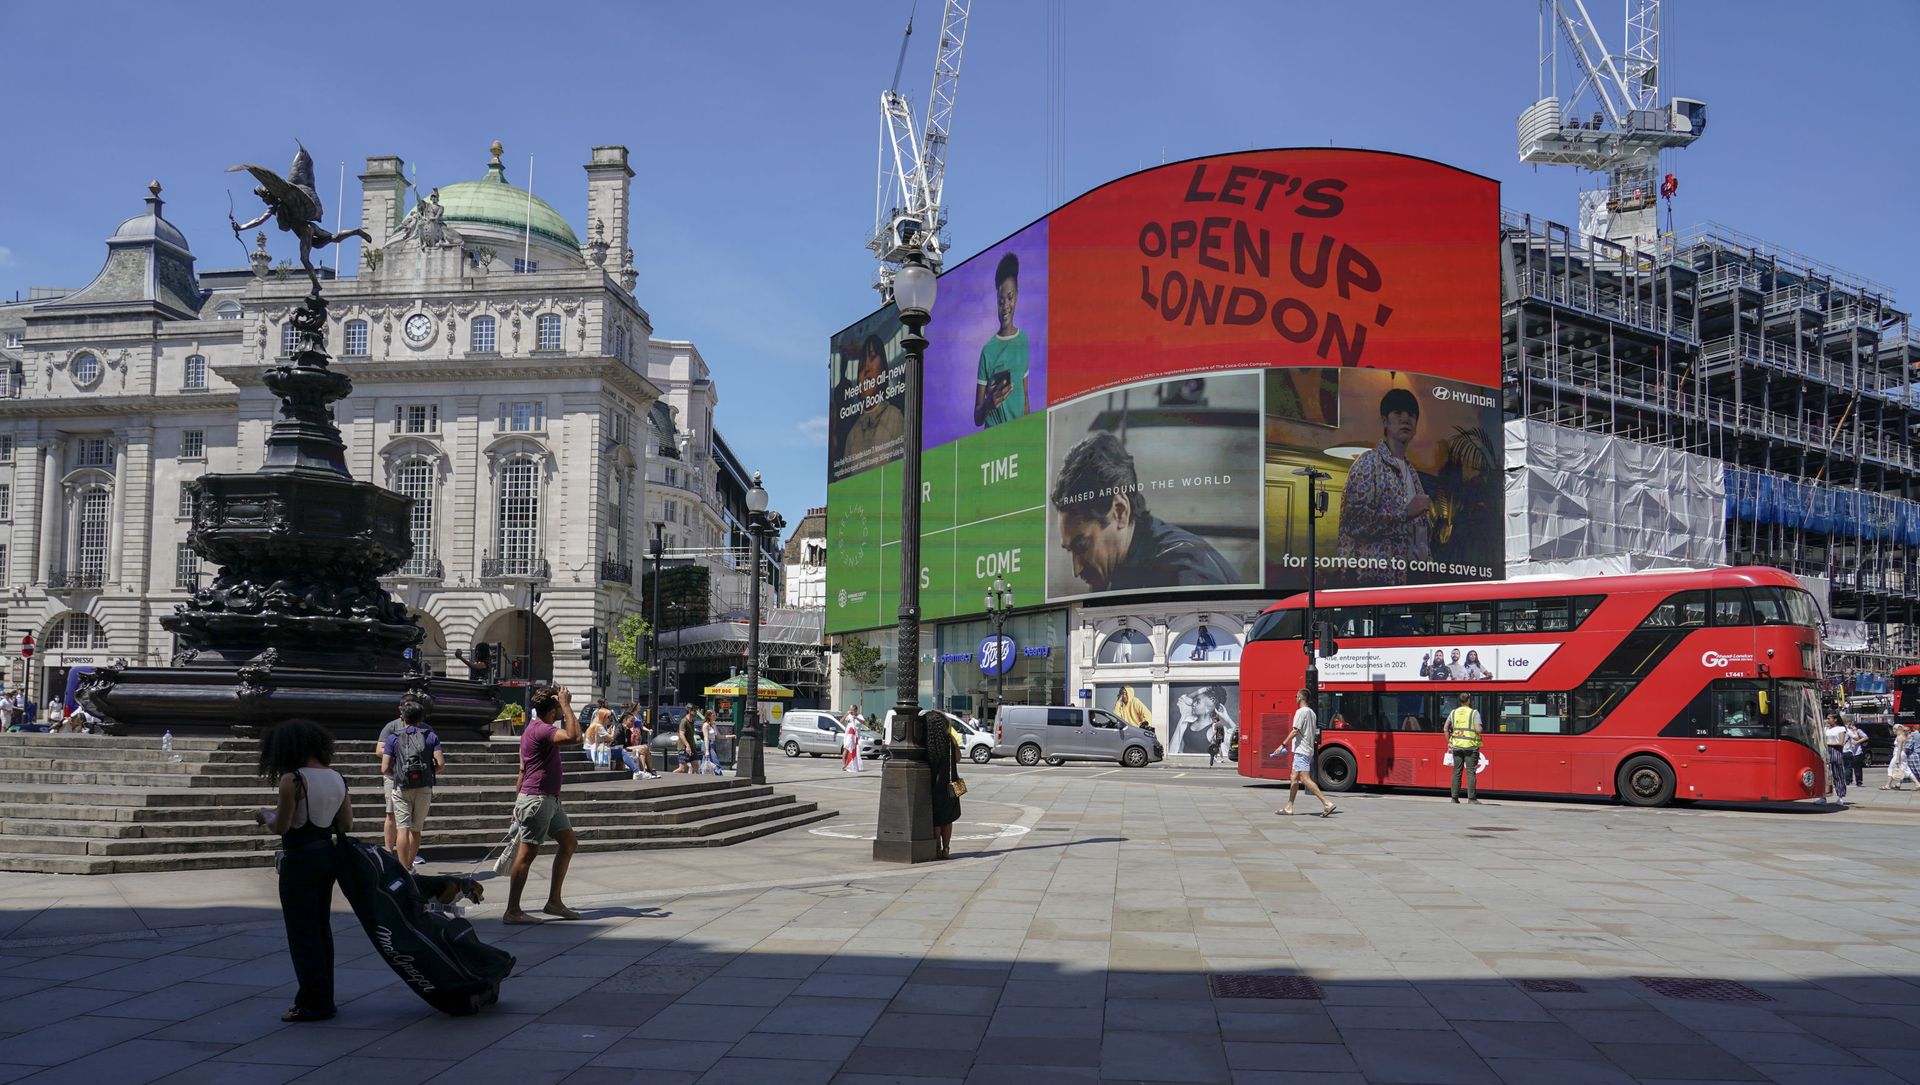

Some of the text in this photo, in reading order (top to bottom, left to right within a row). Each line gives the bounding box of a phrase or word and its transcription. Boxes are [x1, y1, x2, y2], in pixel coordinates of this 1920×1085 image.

[1184, 164, 1349, 218] LET'S
[1138, 216, 1270, 278] OPEN
[1141, 265, 1369, 368] LONDON
[844, 362, 907, 401] Meet the all-new
[839, 399, 865, 420] Galaxy
[865, 391, 885, 409] Book
[1452, 390, 1496, 408] HYUNDAI
[981, 453, 1019, 487] TIME
[1063, 475, 1232, 505] RAISED AROUND THE WORLD
[975, 547, 1021, 579] COME
[1282, 552, 1493, 578] for someone to come save us
[1339, 654, 1381, 662] entrepreneur.
[1508, 657, 1530, 667] tide
